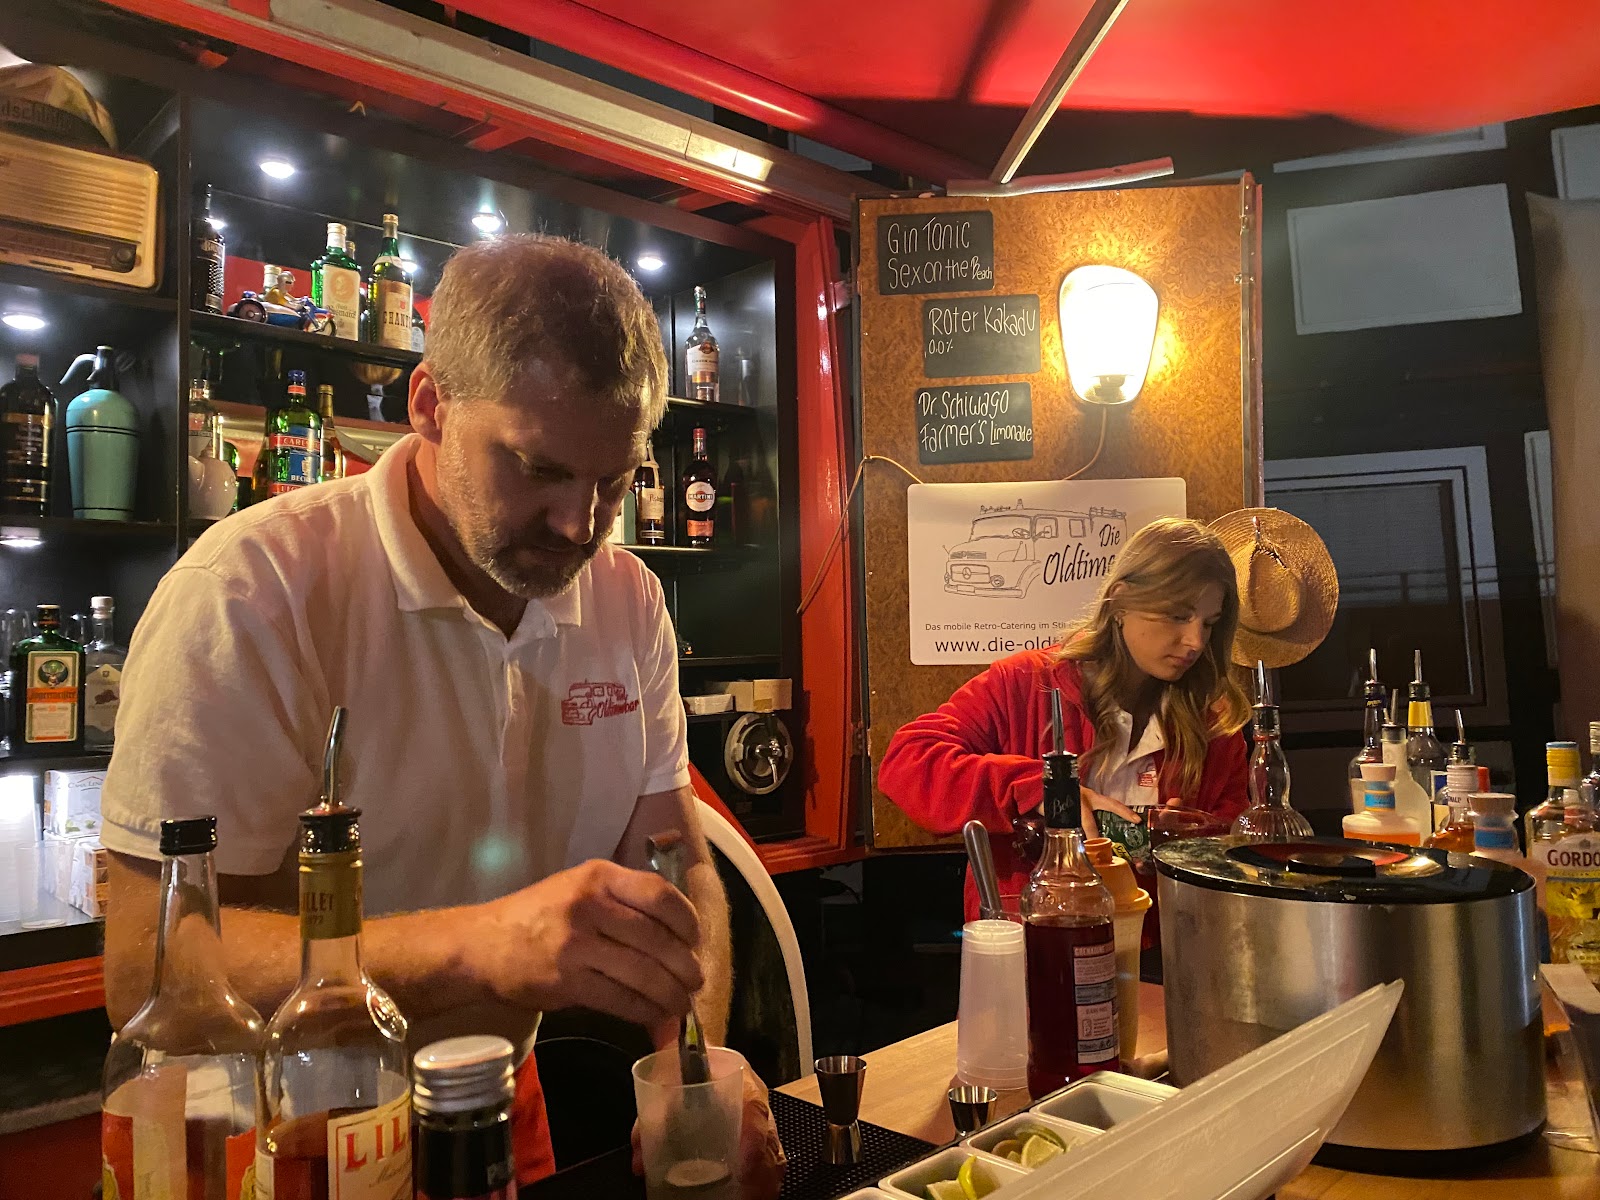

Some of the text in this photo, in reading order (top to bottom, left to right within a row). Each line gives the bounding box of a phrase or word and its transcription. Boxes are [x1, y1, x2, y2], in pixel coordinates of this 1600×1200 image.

[887, 217, 970, 254] Gin Tonic
[887, 255, 993, 289] Sex on the Beach
[928, 303, 1036, 336] Roter Kakadu
[918, 389, 1009, 420] Dr. Schiwago
[990, 420, 1033, 446] Limonade
[1099, 523, 1120, 547] Die
[925, 623, 941, 631] Das
[943, 622, 972, 631] mobile
[974, 621, 1036, 631] Retro-Catering
[1038, 622, 1050, 630] im
